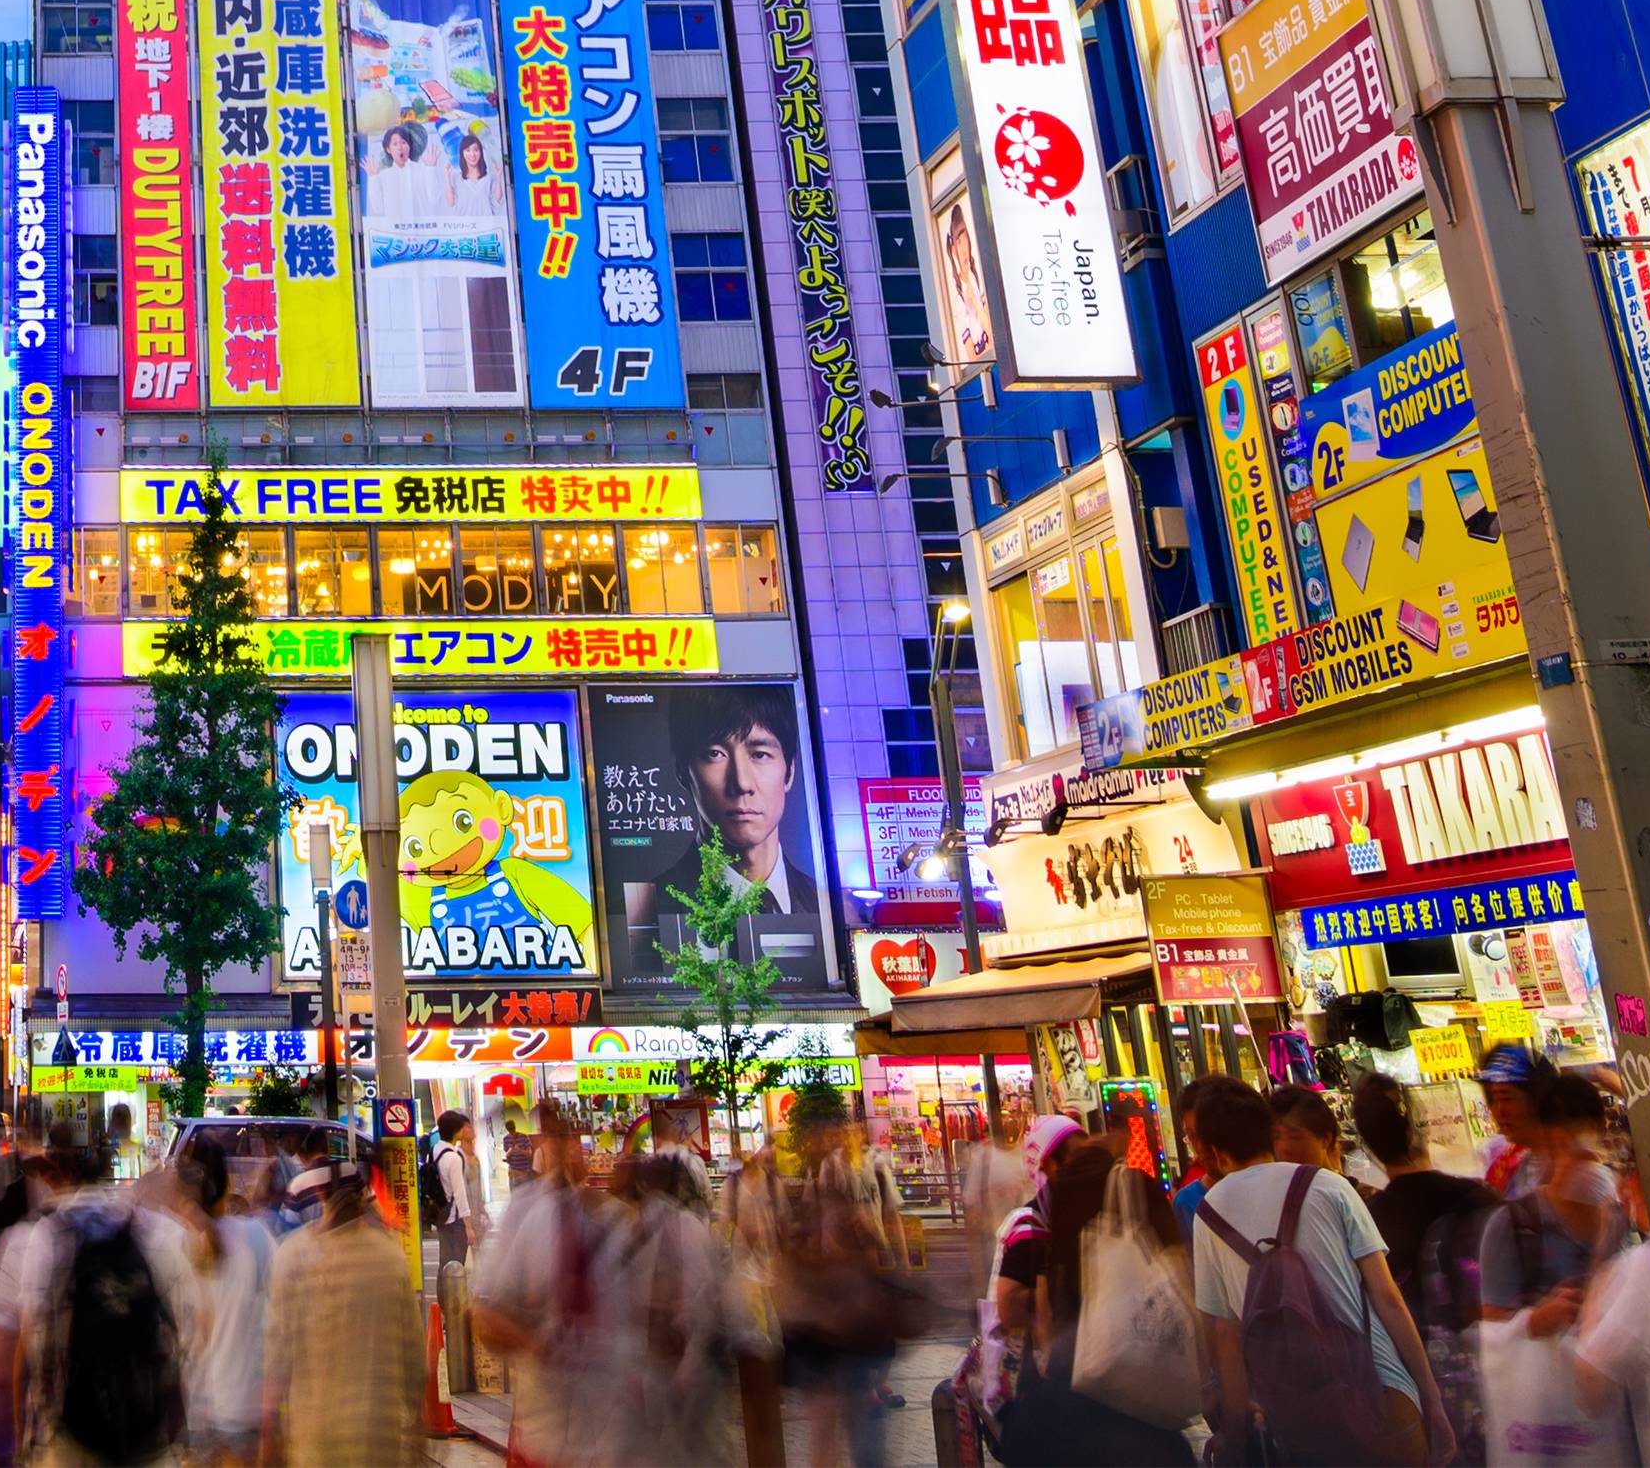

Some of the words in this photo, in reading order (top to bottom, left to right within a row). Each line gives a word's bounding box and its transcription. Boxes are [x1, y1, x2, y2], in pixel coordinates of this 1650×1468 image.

[1228, 56, 1259, 96] B1
[1308, 155, 1399, 250] TAKARADA
[16, 112, 57, 349] Panasonic
[370, 232, 502, 265] マジック大容量
[1022, 264, 1046, 329] Shop
[1041, 228, 1071, 328] Tax-free
[1072, 238, 1102, 325] Japan.
[131, 362, 192, 399] B1F
[22, 383, 54, 589] ONODEN
[1315, 437, 1347, 489] 2F
[259, 478, 381, 515] FREE
[395, 478, 506, 513] 免税店
[394, 630, 533, 665] エアコン
[1296, 611, 1386, 664] DISCOUNT
[1142, 670, 1211, 716] DISCOUNT
[1291, 665, 1330, 709] GSM
[1332, 639, 1414, 693] MOBILES
[605, 694, 654, 705] Panasonic
[1142, 702, 1228, 749] COMPUTERS
[18, 623, 57, 886] オノデン
[603, 765, 660, 789] 教えて
[605, 793, 686, 814] あげたい
[1145, 881, 1166, 900] 2F
[1157, 922, 1204, 936] Tax-free
[1218, 920, 1263, 934] Discount
[1157, 944, 1180, 963] B1
